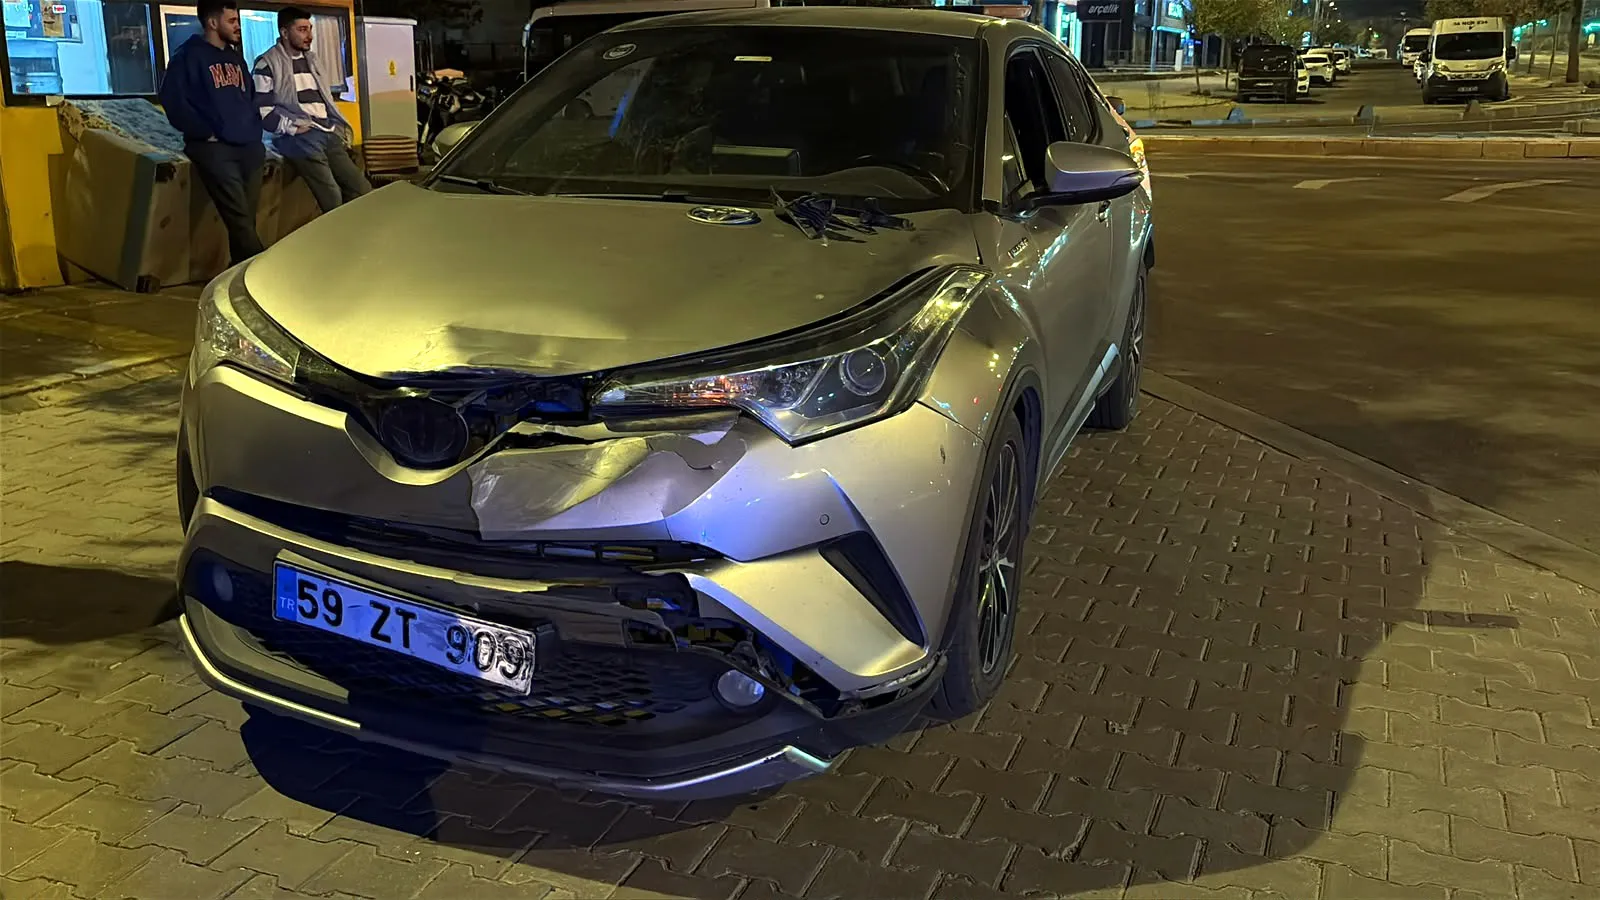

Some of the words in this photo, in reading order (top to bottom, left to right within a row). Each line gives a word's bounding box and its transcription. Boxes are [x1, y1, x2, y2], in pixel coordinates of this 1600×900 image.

[1088, 4, 1119, 15] arçelik
[280, 596, 296, 611] TR
[297, 579, 343, 627] 59
[369, 600, 417, 649] ZT
[445, 624, 525, 680] 909
